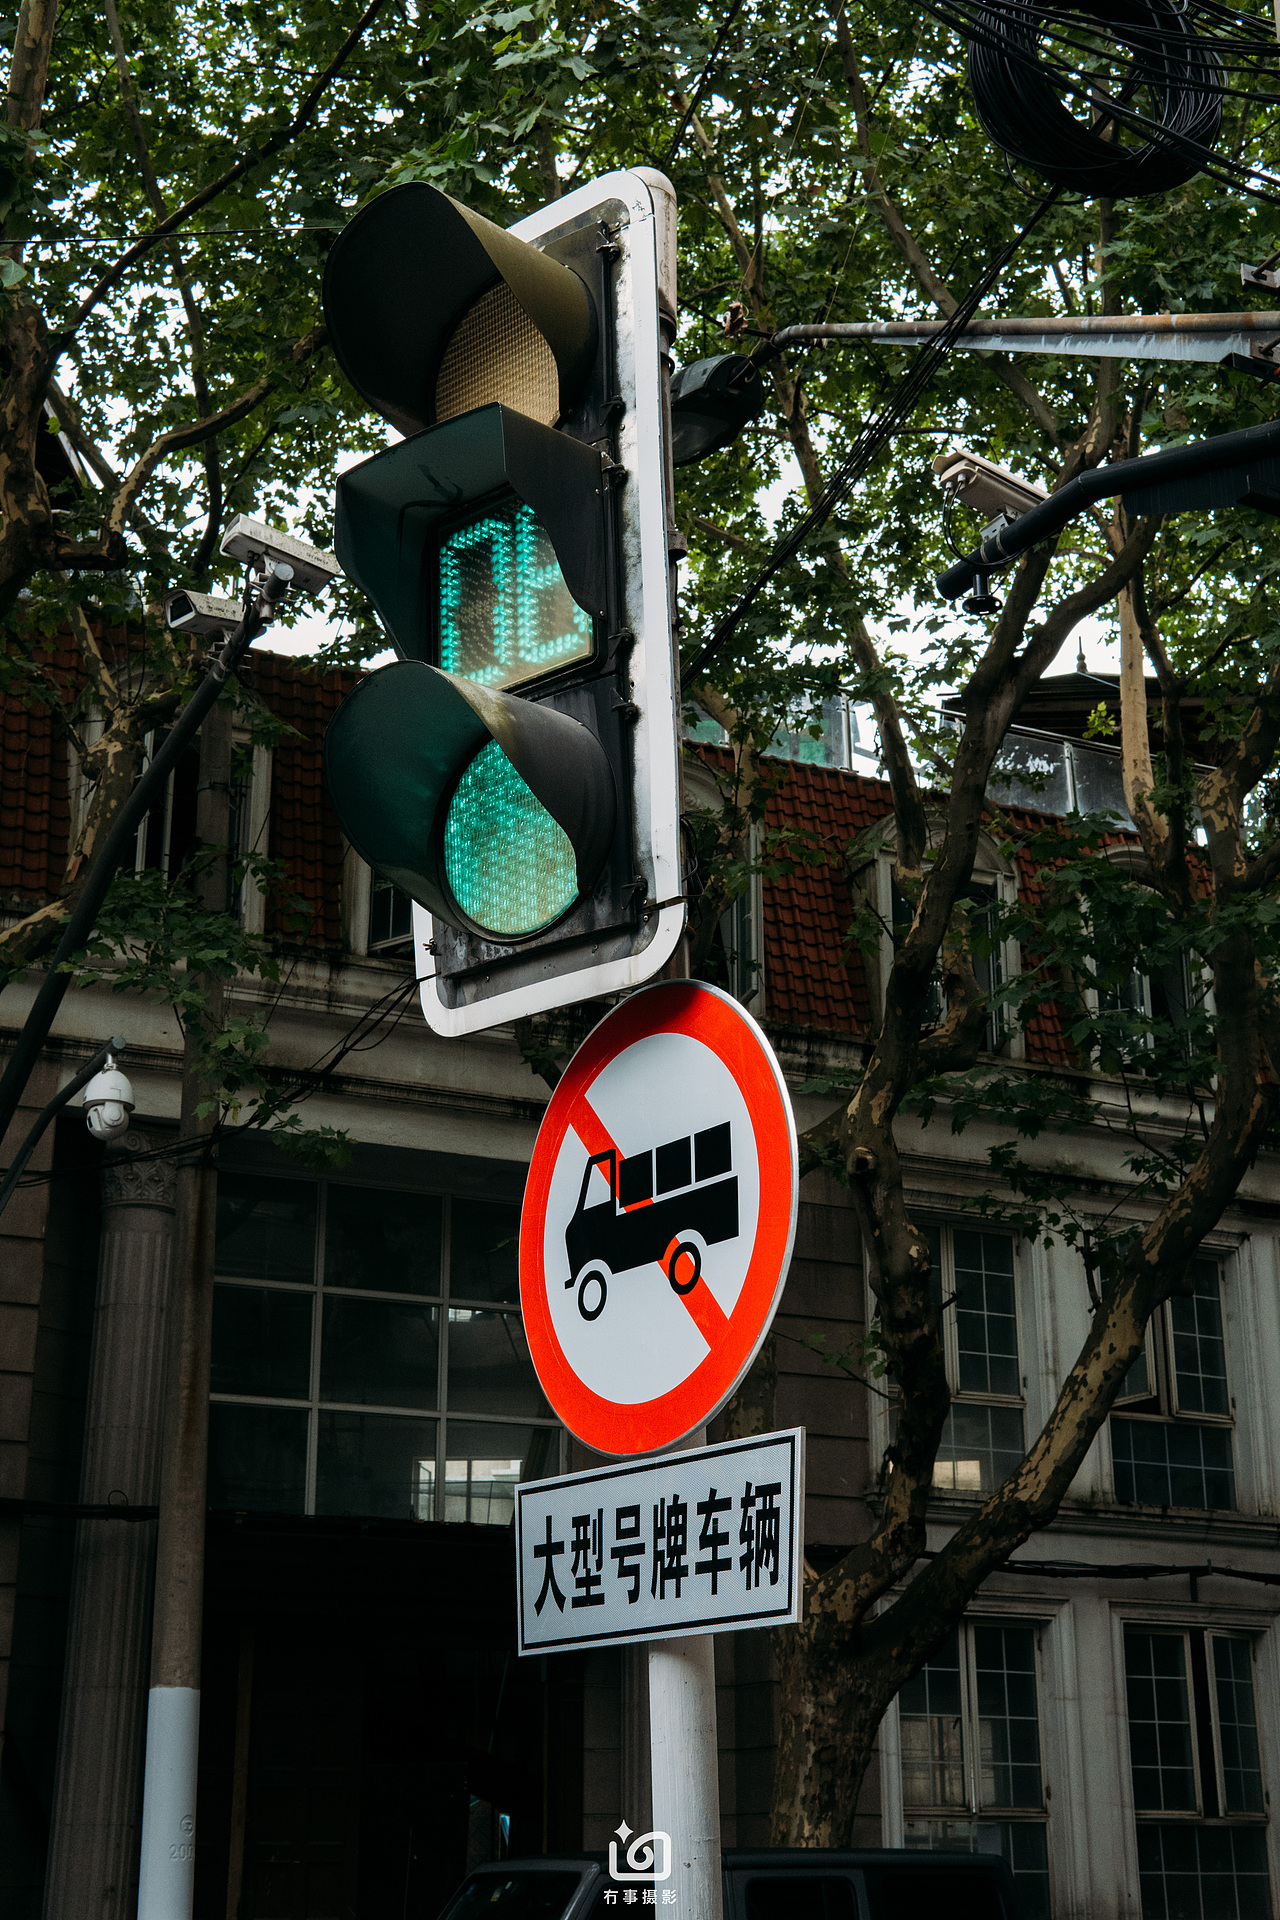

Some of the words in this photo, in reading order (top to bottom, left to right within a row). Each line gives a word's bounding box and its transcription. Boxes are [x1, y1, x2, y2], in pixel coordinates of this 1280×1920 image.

[533, 1481, 782, 1617] 大型号牌车辆
